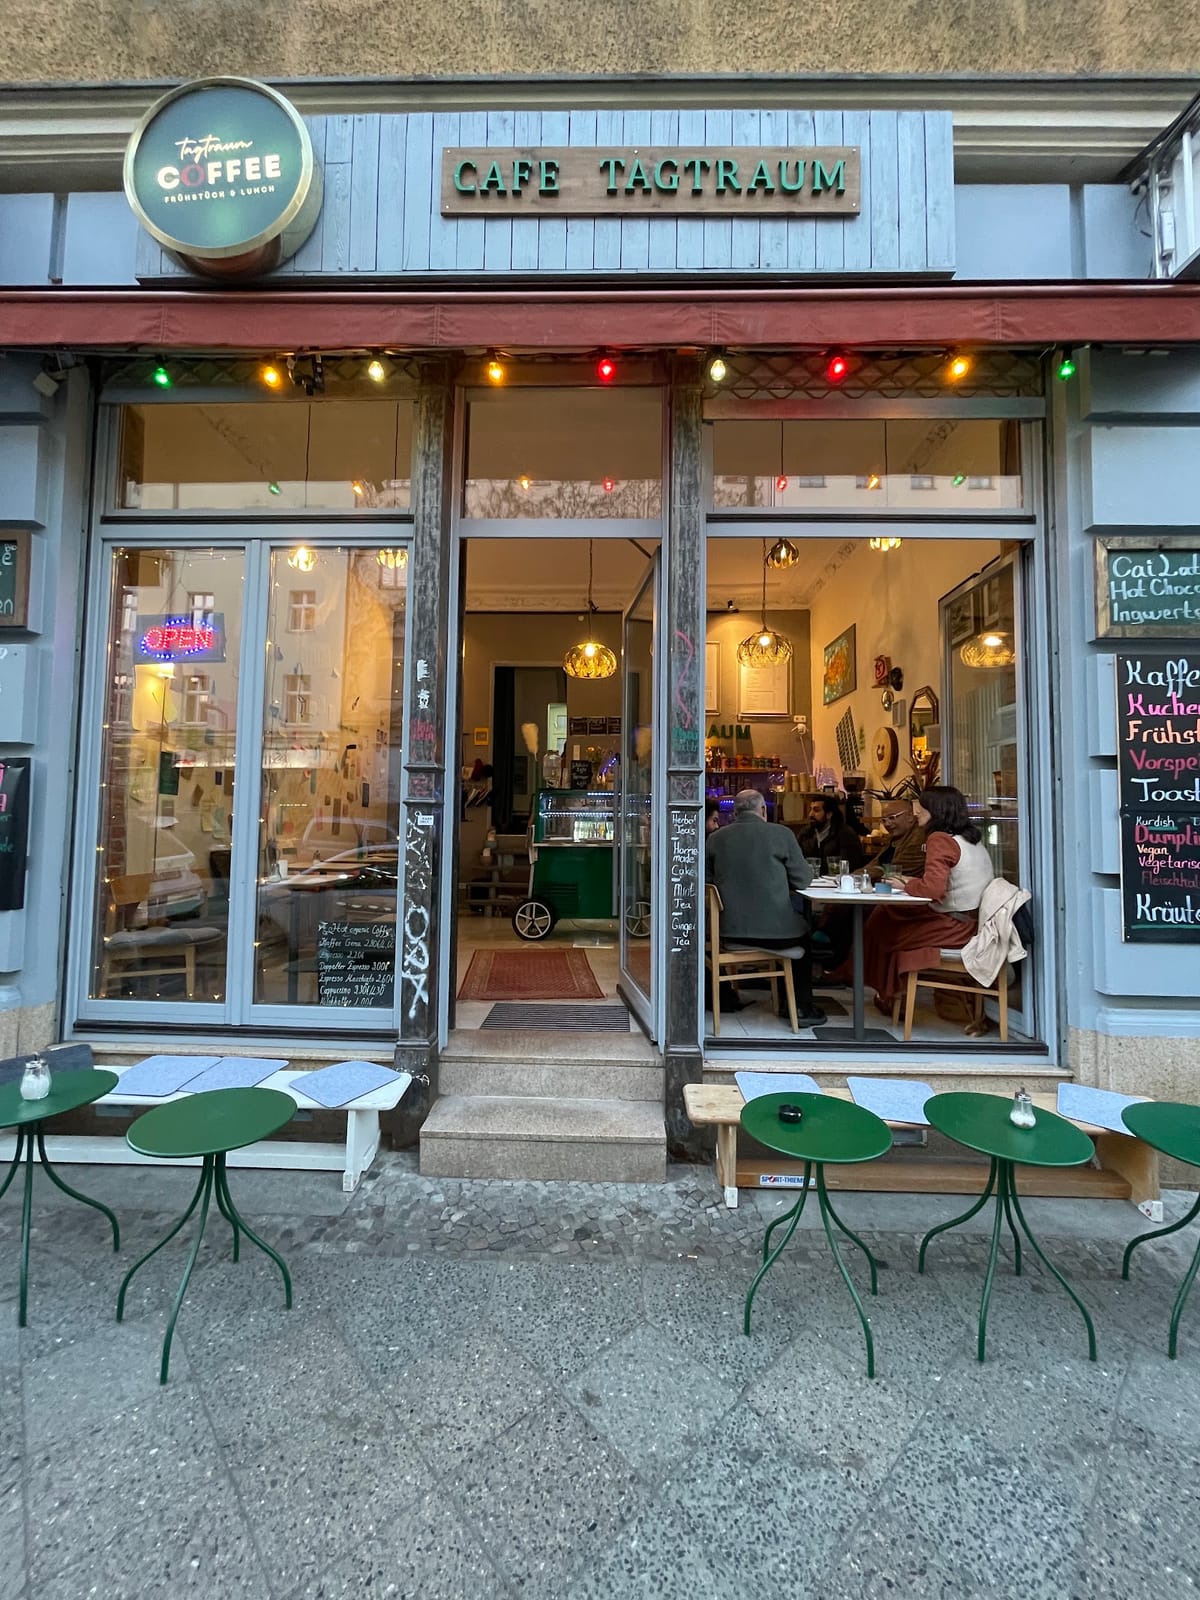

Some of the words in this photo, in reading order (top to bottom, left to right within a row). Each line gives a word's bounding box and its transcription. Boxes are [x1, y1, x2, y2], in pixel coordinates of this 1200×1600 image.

[157, 154, 281, 190] COFFEE
[454, 160, 560, 196] CAFE
[600, 158, 847, 196] TAGTRAUM
[164, 190, 225, 204] FRÜHSTÜCK
[240, 185, 275, 196] LUNCH
[1110, 579, 1148, 600] Hot
[145, 627, 213, 649] OPEN
[1126, 691, 1200, 716] Kuche
[1129, 749, 1200, 780] Vorspe
[674, 824, 696, 835] Teas
[1136, 815, 1175, 827] Kurdish
[1137, 844, 1169, 861] Vegan
[673, 883, 696, 897] Mint
[674, 898, 692, 909] Tea
[673, 937, 690, 946] Tea
[761, 1175, 805, 1184] SPORT-THIEM
